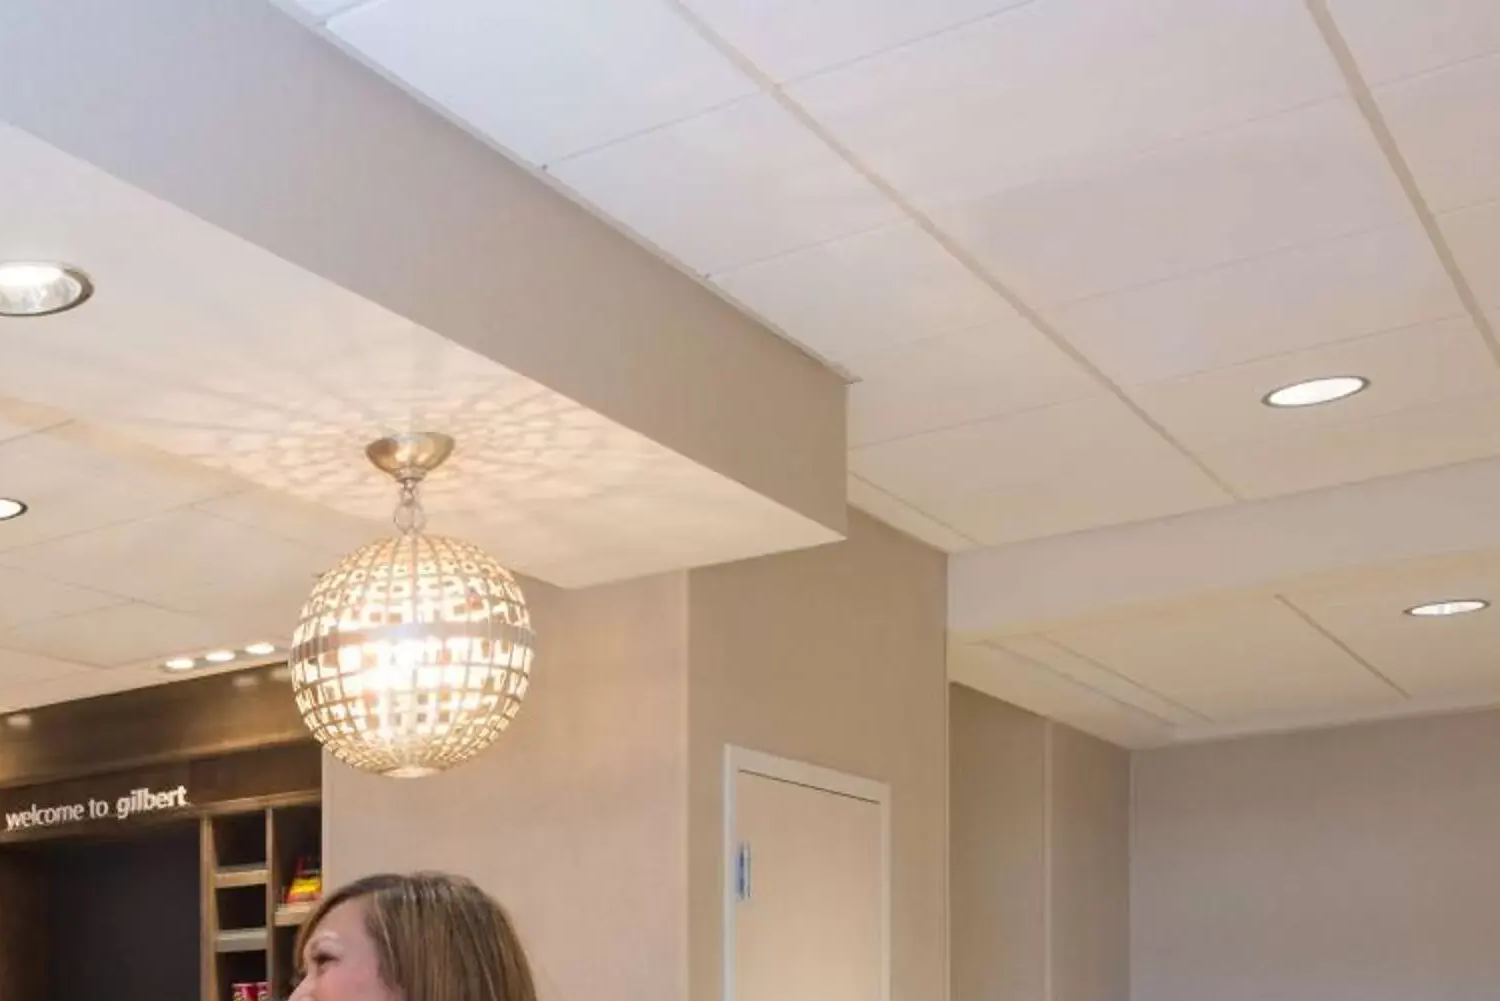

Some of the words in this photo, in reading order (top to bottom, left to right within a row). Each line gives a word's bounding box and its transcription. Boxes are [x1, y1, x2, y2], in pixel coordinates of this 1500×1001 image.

[5, 803, 84, 831] welcome
[89, 799, 109, 819] to
[116, 785, 188, 819] gilbert
